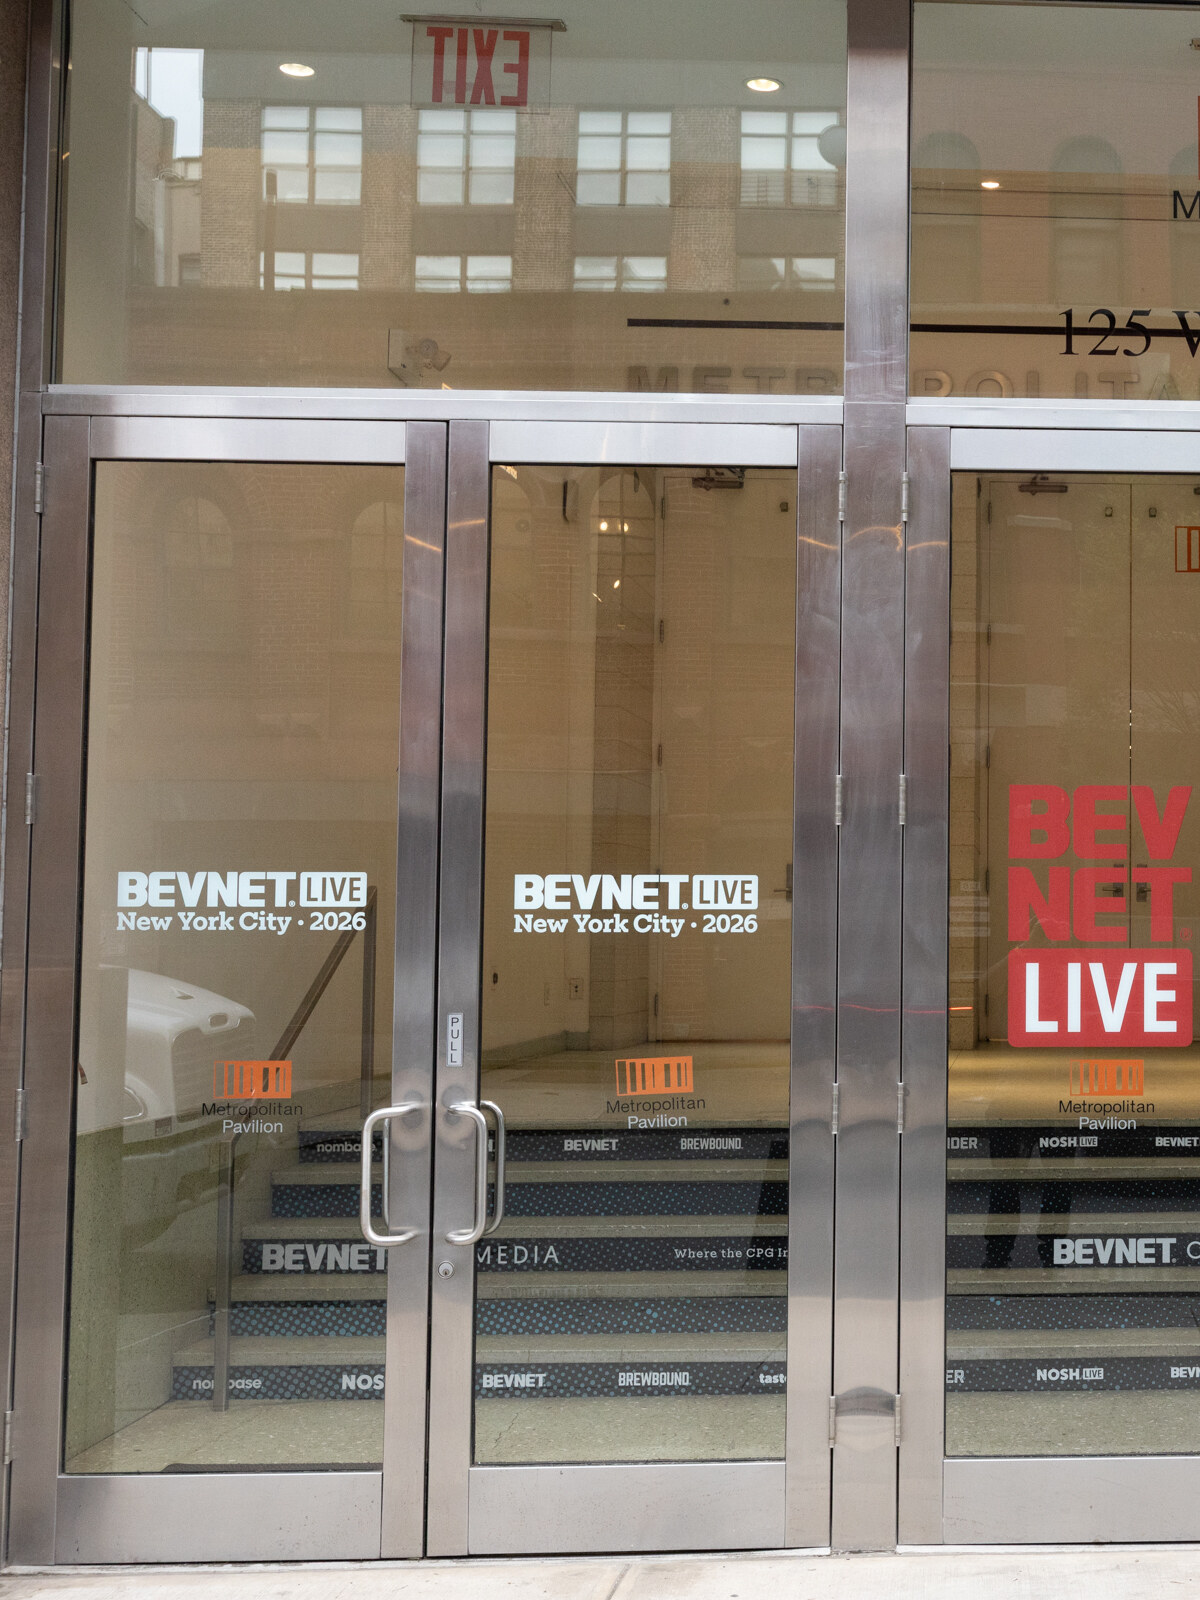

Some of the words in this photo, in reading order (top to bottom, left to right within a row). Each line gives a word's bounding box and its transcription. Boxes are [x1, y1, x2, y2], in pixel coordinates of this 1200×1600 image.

[1058, 308, 1152, 357] 125
[1008, 784, 1193, 860] BEV
[117, 871, 297, 907] BEVNET
[305, 876, 362, 902] LIVE
[514, 874, 689, 910] BEVNET
[698, 879, 753, 904] LIVE
[1008, 866, 1193, 942] NET
[117, 912, 173, 931] New
[177, 912, 235, 931] York
[239, 912, 293, 935] City
[309, 912, 366, 931] 2026
[513, 914, 569, 933] New
[573, 914, 629, 933] York
[633, 914, 685, 937] City
[702, 914, 758, 933] 2026
[1025, 962, 1178, 1033] LIVE
[450, 1017, 460, 1064] PULL
[201, 1103, 303, 1118] Metropolitan
[606, 1097, 706, 1114] Metropolitan
[1058, 1100, 1156, 1116] Metropolitan
[222, 1121, 284, 1134] Pavilion
[627, 1115, 688, 1129] Pavilion
[1078, 1117, 1137, 1131] Pavilion
[564, 1139, 618, 1151] BEVNET
[680, 1138, 742, 1150] BREWBOUND
[1039, 1137, 1077, 1148] NOSH
[1081, 1138, 1097, 1146] LIVE
[1155, 1137, 1199, 1147] BEVNET
[261, 1243, 386, 1270] BEVNET
[477, 1245, 560, 1265] MEDIA
[674, 1248, 718, 1259] Where
[720, 1248, 743, 1258] the
[745, 1248, 775, 1259] CPG
[1053, 1238, 1177, 1264] BEVNET
[482, 1373, 546, 1388] BEVNET
[618, 1372, 690, 1386] BREWBOUND
[759, 1373, 787, 1384] tast
[1036, 1368, 1080, 1381] NOSH
[1085, 1369, 1102, 1379] LIVE
